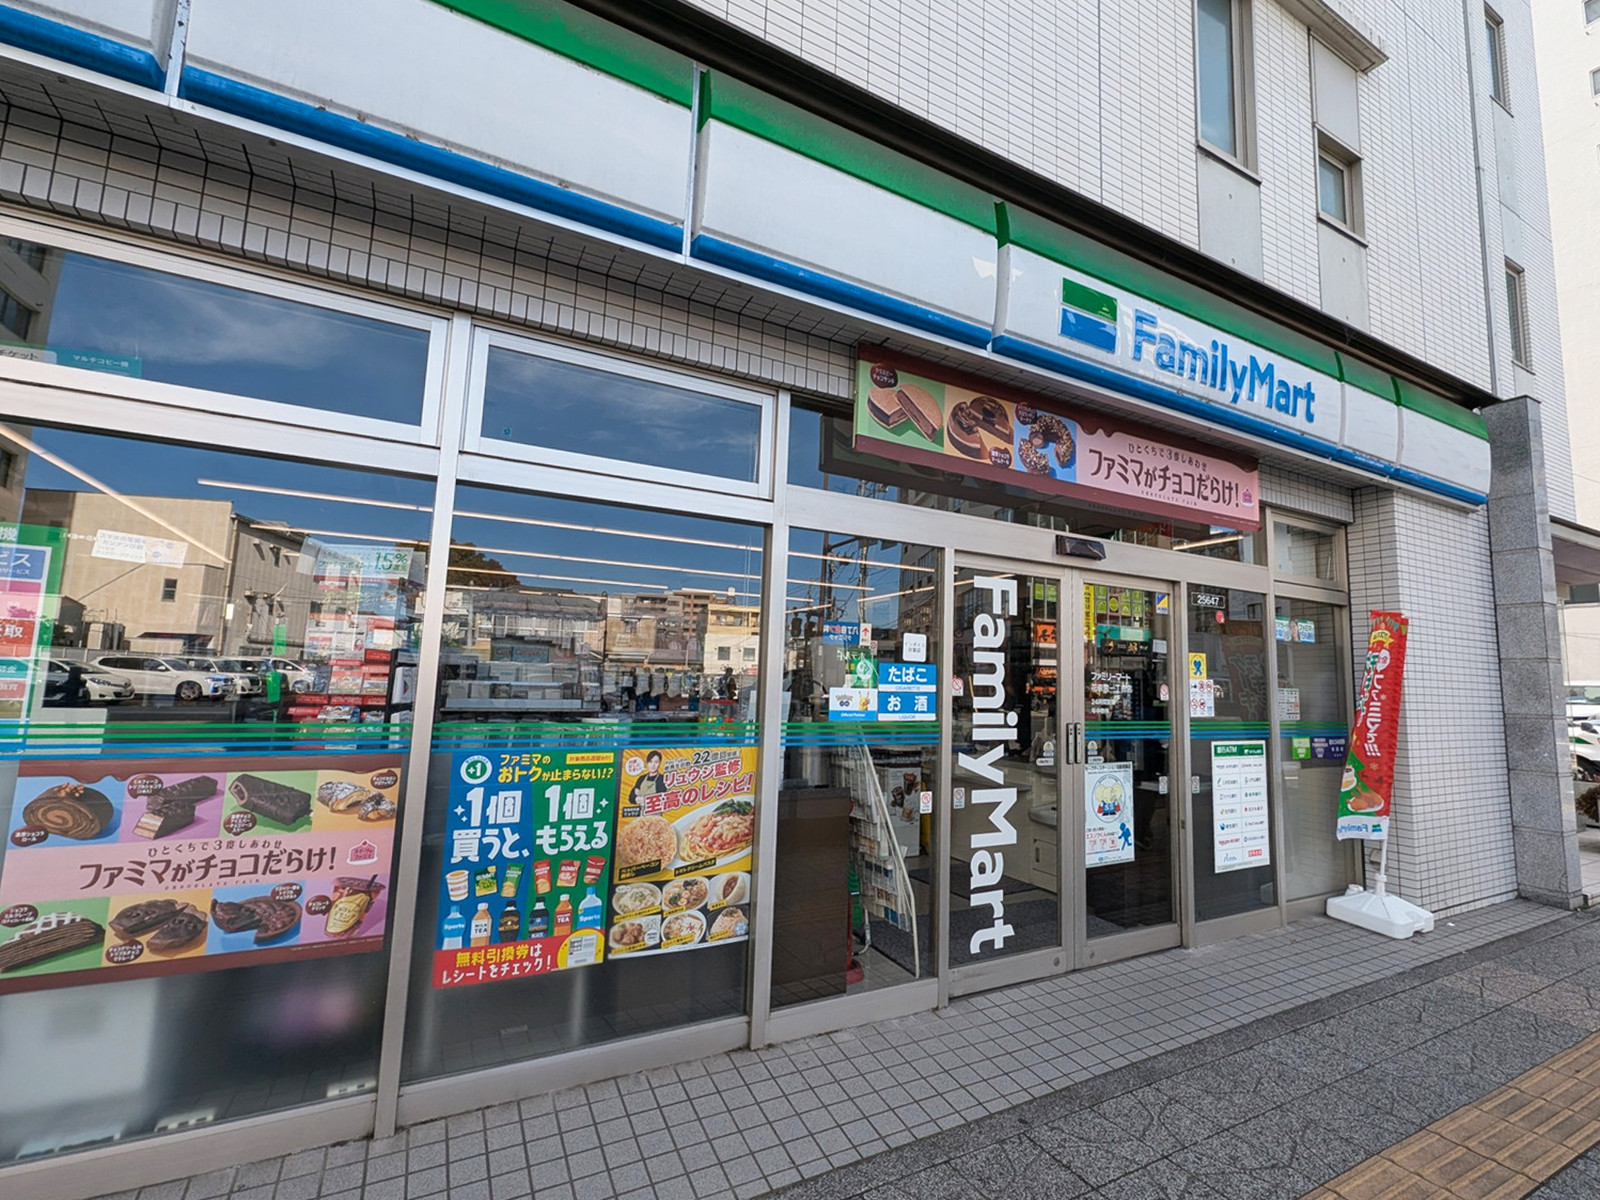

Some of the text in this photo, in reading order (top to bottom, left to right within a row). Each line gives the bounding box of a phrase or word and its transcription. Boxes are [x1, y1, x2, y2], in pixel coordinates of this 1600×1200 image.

[1132, 308, 1316, 423] FamilyMart
[1197, 595, 1220, 606] 25647
[888, 666, 928, 683] たばこ
[500, 753, 551, 766] ファミマの
[664, 759, 741, 788] リュウジ監修
[958, 574, 1018, 954] FamilyMart
[466, 787, 522, 827] 1個
[544, 785, 595, 823] 1個
[148, 839, 283, 858] ひとくちで3度しあわせ
[535, 821, 609, 855] もらえる
[79, 846, 337, 891] ファミマがチョコだらけ!
[442, 955, 552, 985] レシートをチェック!
[456, 943, 543, 968] 無料引換券は
